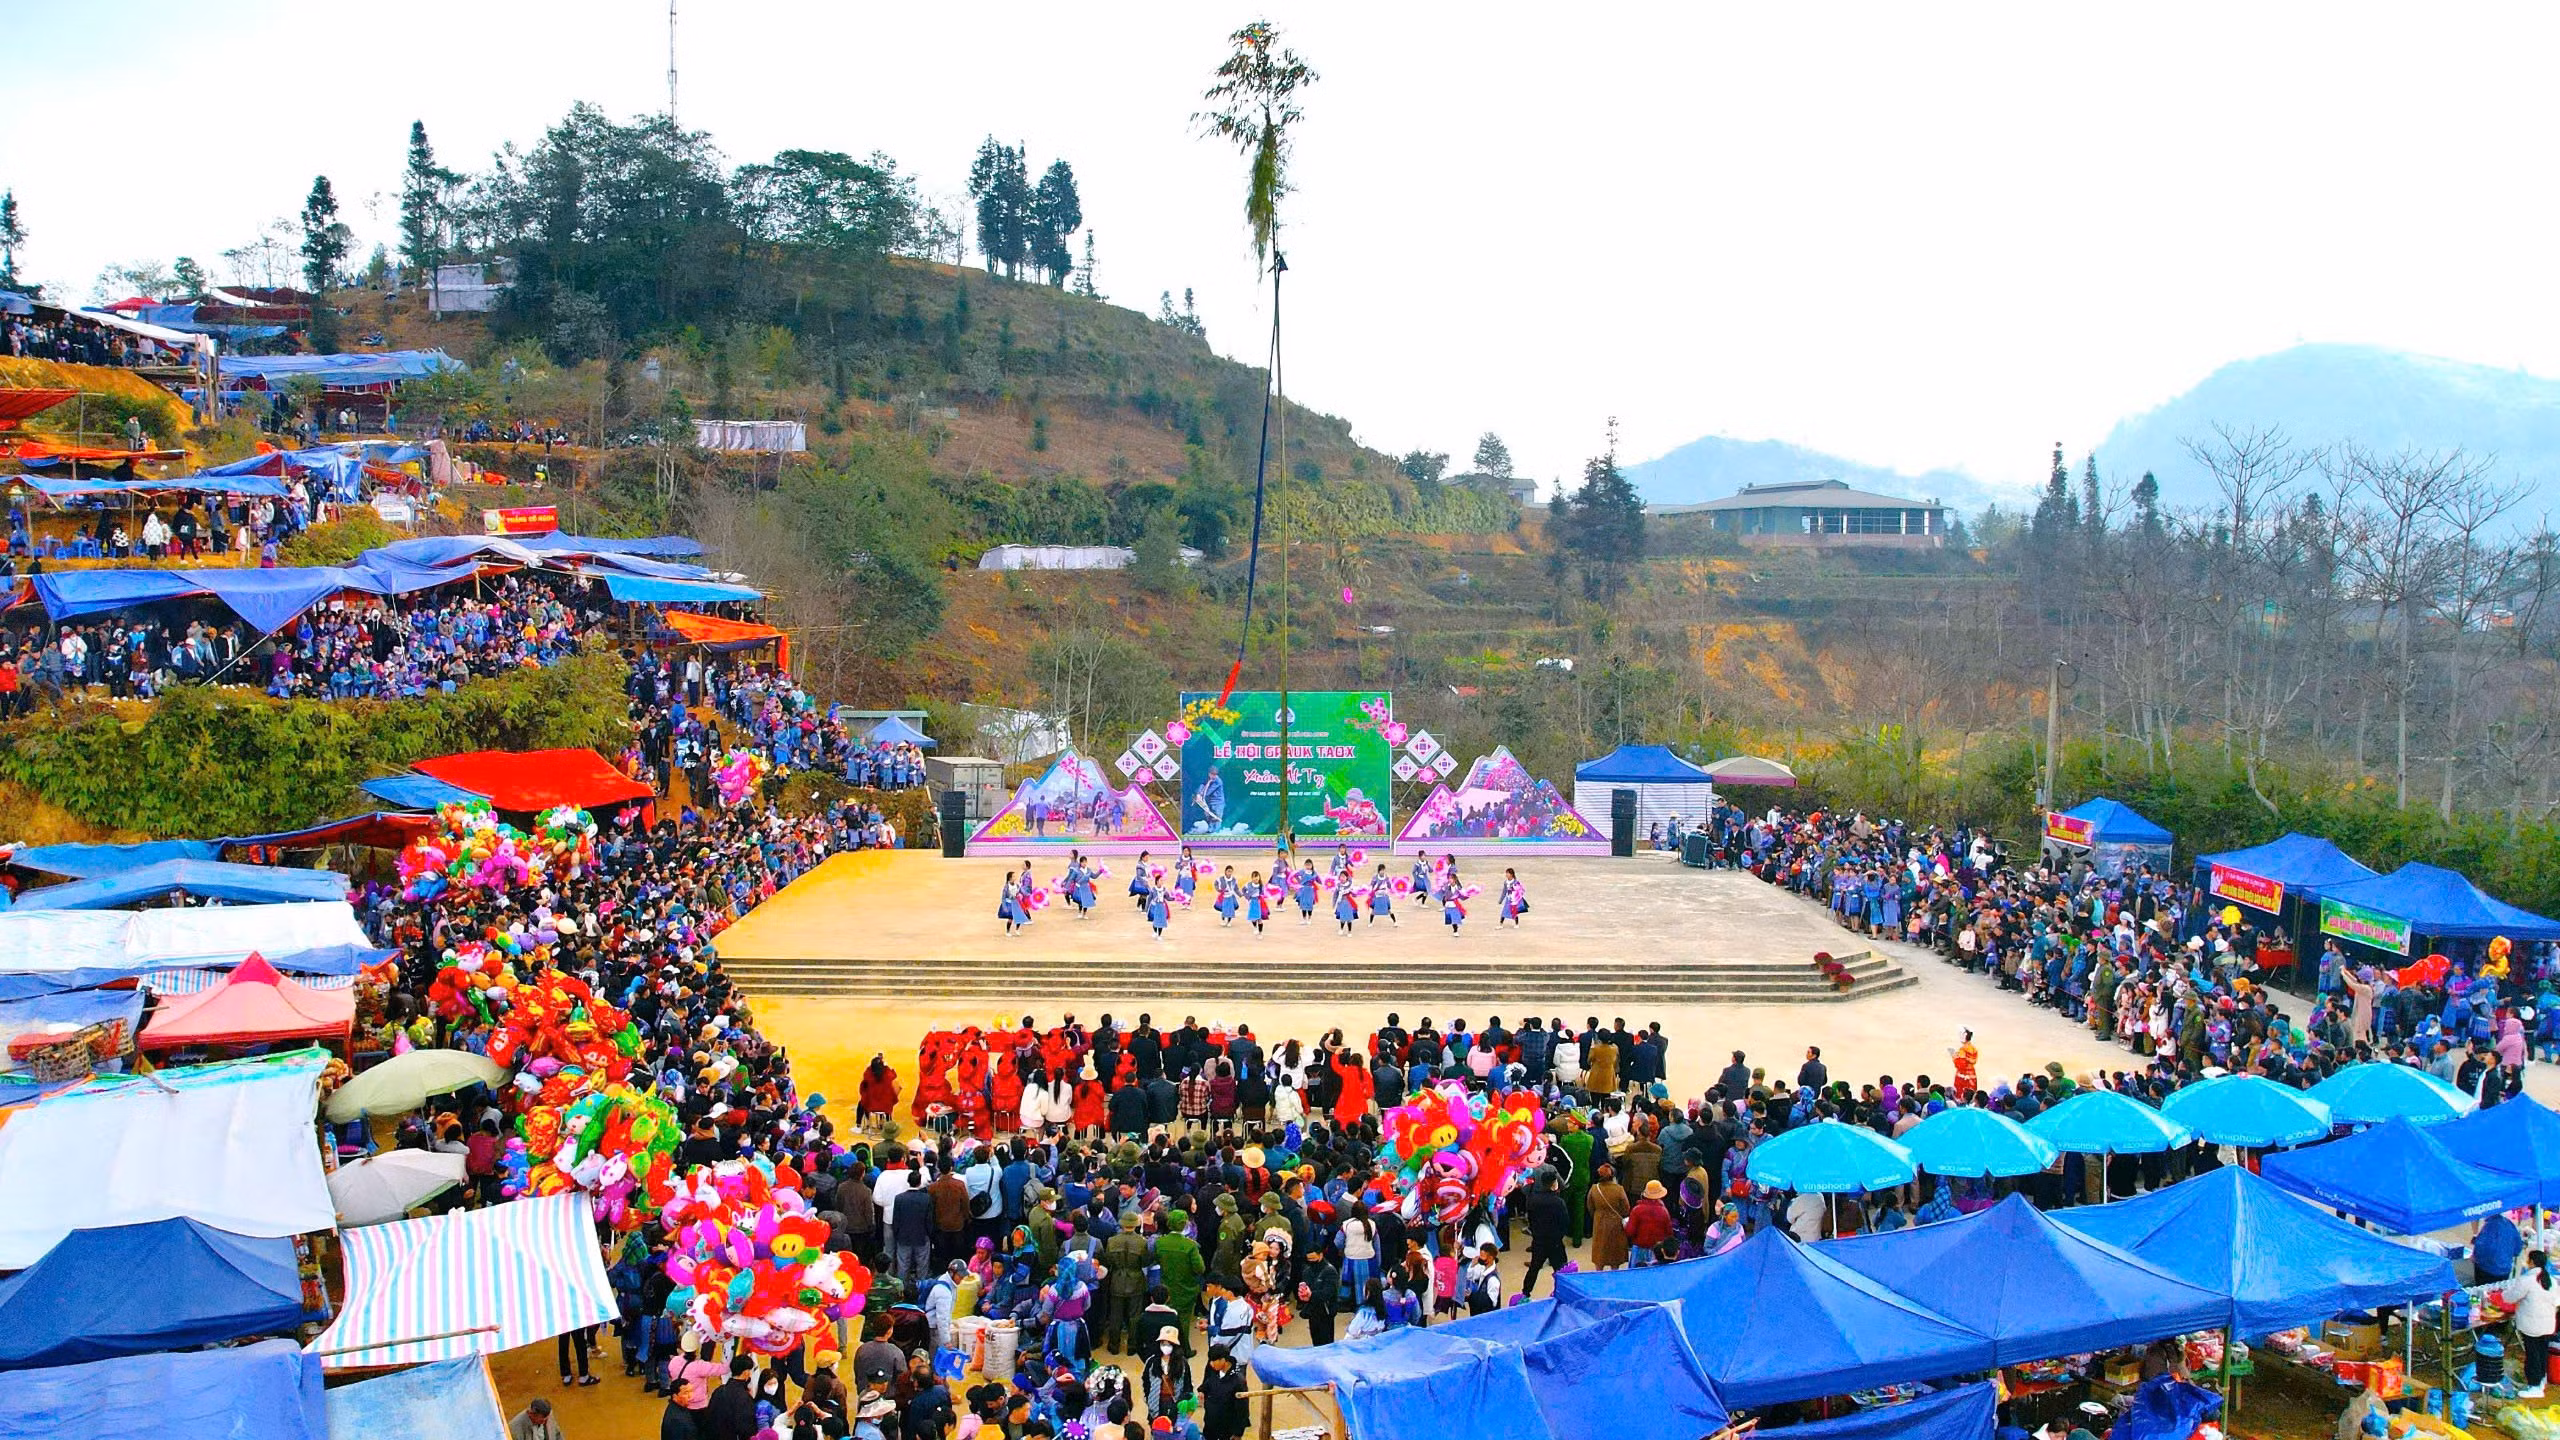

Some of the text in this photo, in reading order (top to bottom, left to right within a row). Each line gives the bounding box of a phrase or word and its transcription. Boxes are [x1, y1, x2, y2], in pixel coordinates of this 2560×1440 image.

[1213, 741, 1231, 758] LỄ
[1235, 743, 1261, 761] HỘI
[1316, 746, 1356, 758] TAOX
[1803, 1182, 1851, 1192] vinaphone
